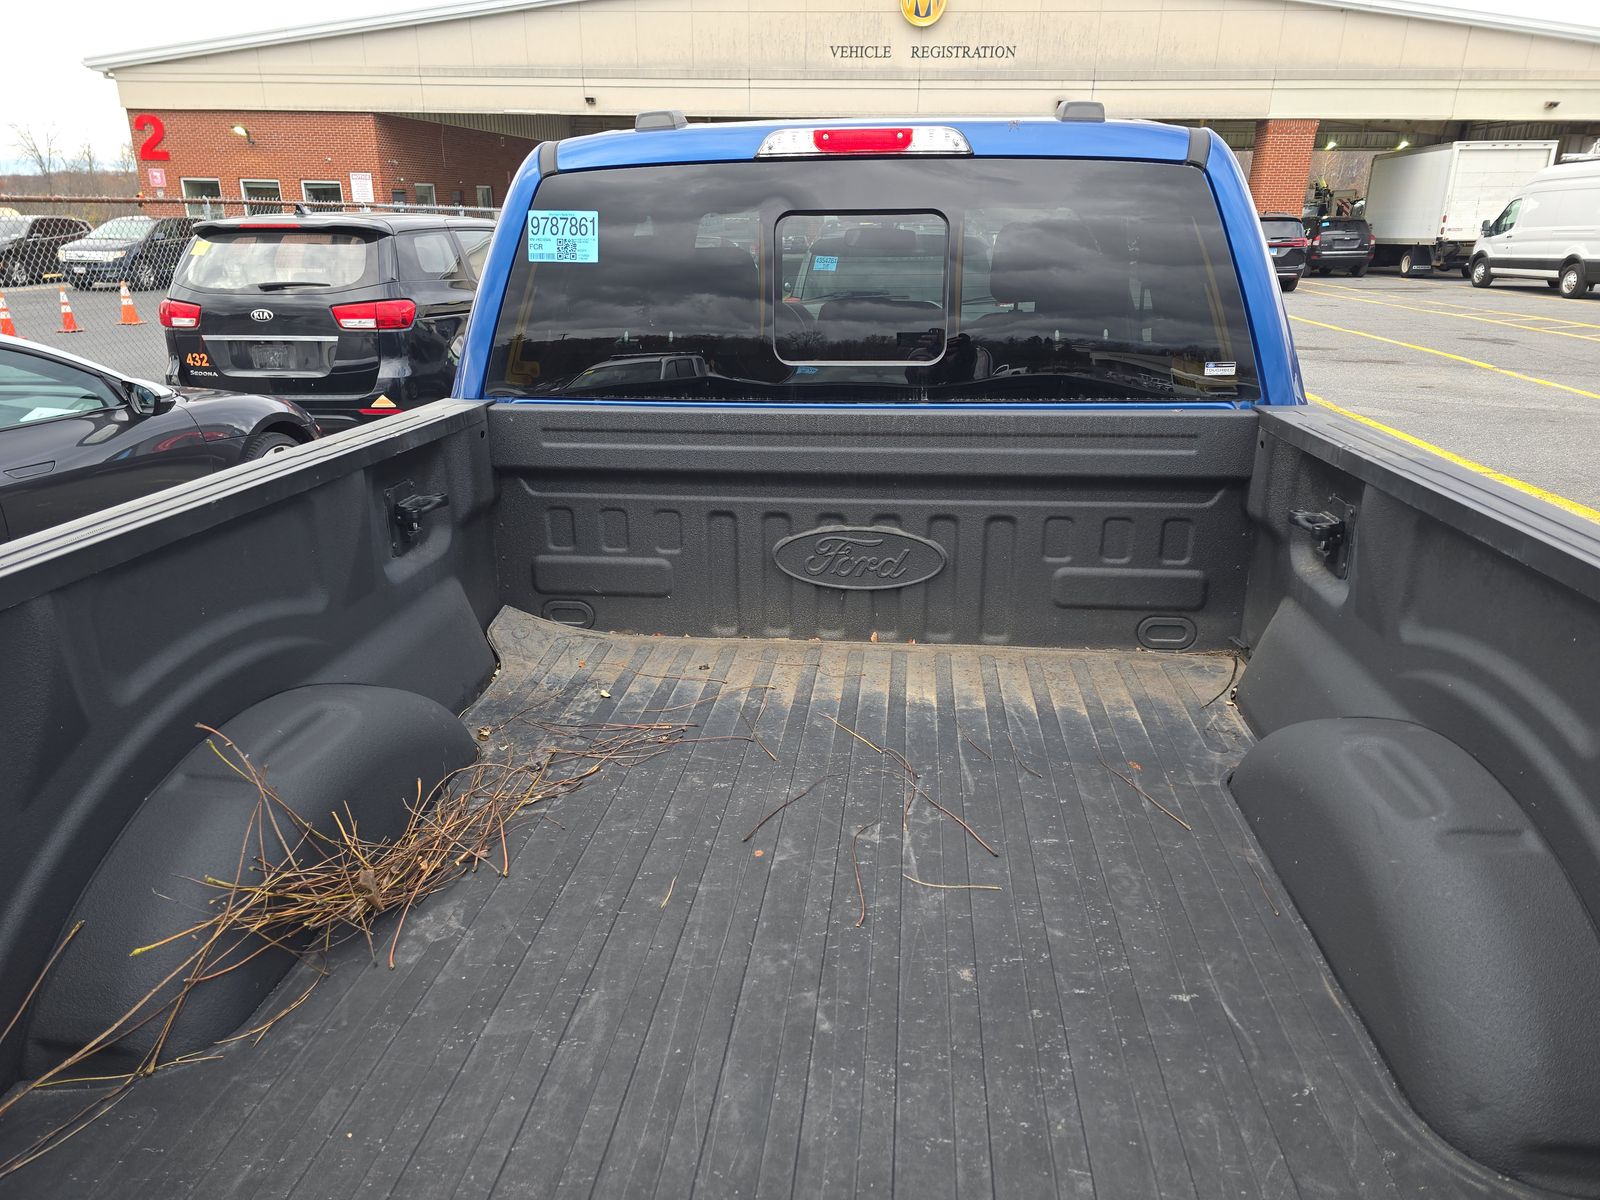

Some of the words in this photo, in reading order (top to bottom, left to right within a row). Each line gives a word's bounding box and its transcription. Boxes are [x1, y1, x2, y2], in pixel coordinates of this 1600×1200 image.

[830, 45, 892, 59] VEHICLE
[910, 45, 1017, 59] REGISTRATION
[134, 112, 170, 161] 2
[530, 216, 595, 236] 9787861
[253, 310, 271, 320] KIA
[186, 353, 209, 367] 432
[804, 536, 910, 578] Ford
